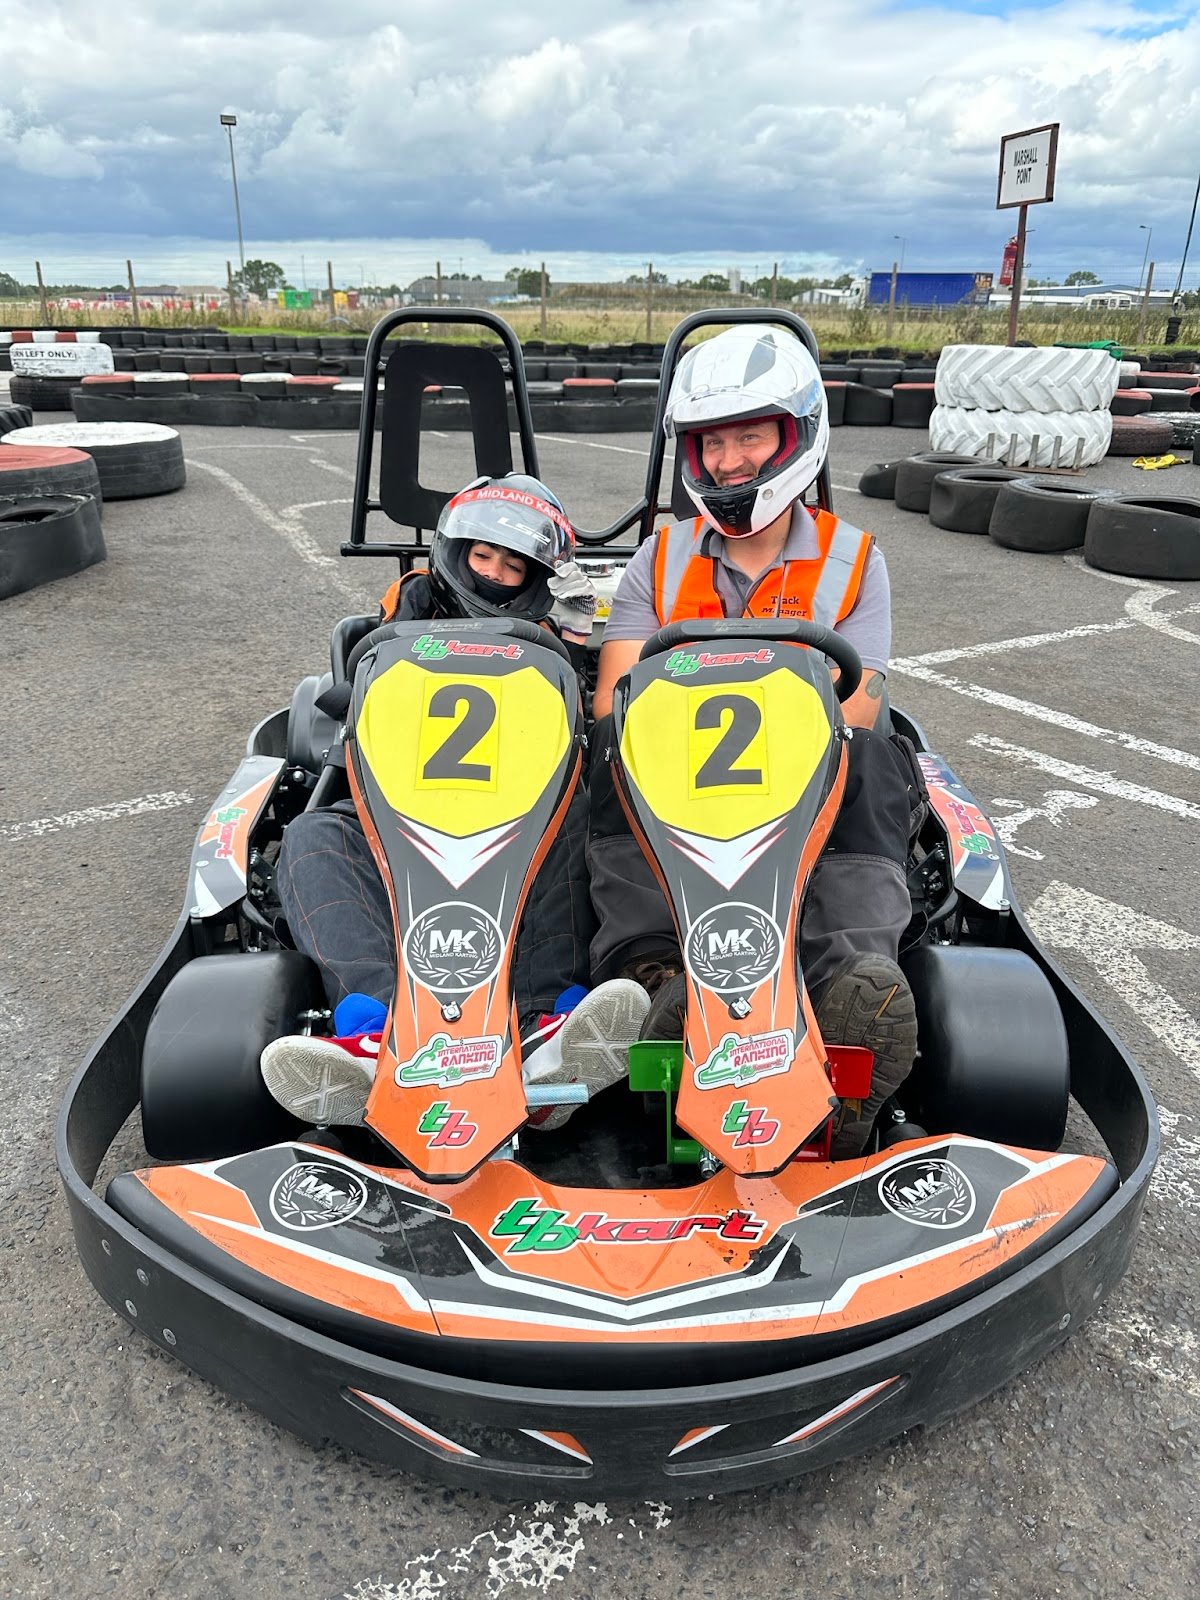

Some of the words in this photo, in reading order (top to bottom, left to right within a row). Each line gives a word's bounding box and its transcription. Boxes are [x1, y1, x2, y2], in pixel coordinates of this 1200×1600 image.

[1013, 147, 1038, 167] MARSHALL
[1016, 167, 1032, 185] POINT
[25, 350, 45, 358] LEFT
[477, 489, 534, 505] MIDLAND
[497, 516, 551, 545] LS2
[771, 595, 799, 605] Tack
[762, 607, 807, 617] Mnager
[422, 684, 497, 783] 2
[694, 694, 762, 790] 2
[429, 929, 478, 954] MK
[708, 928, 757, 956] MK
[709, 952, 733, 961] MIDLAND
[437, 1042, 495, 1057] INTERNATIONAL
[729, 1037, 786, 1057] INTERNATIONAL
[734, 1044, 787, 1068] RANKING
[441, 1050, 495, 1068] RANKING
[296, 1174, 347, 1206] MK
[899, 1171, 949, 1204] MK
